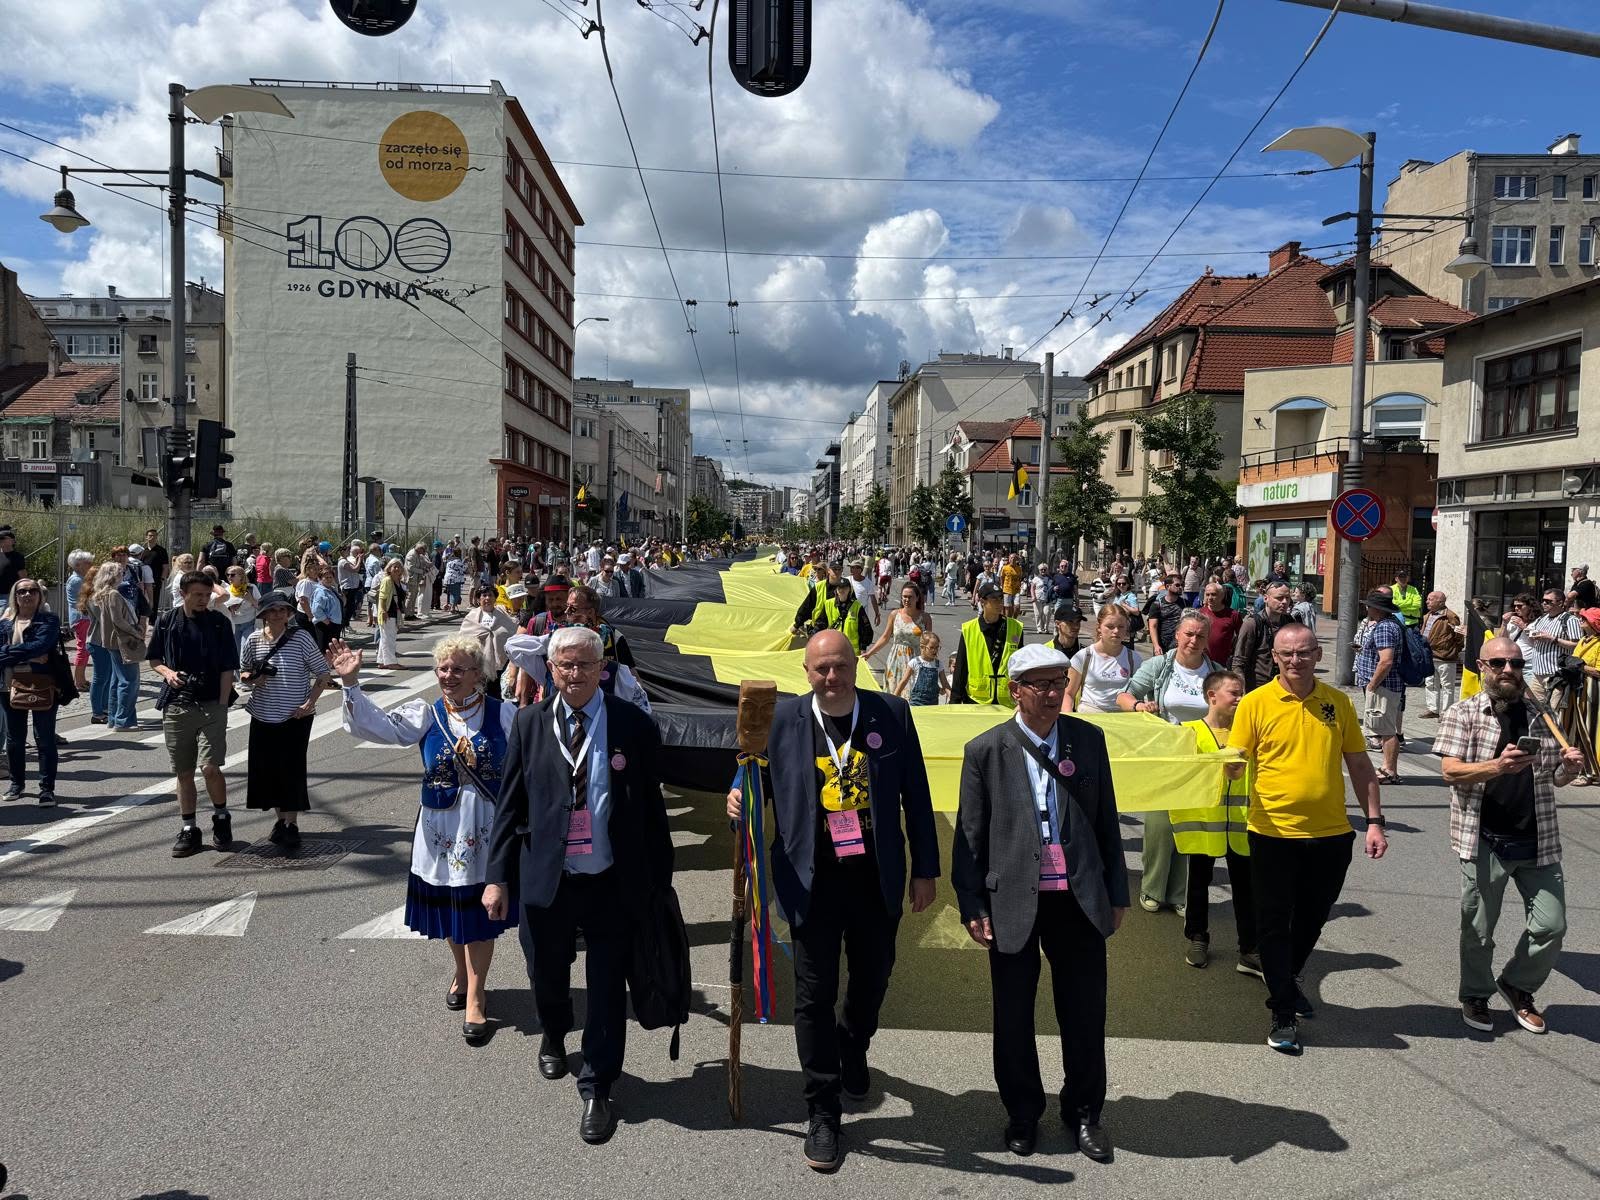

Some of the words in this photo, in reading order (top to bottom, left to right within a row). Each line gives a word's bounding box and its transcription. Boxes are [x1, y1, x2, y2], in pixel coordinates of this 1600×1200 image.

[442, 143, 461, 158] się
[386, 157, 404, 169] od
[408, 160, 452, 170] morza
[287, 215, 451, 273] 100
[287, 283, 311, 292] 1926
[318, 279, 420, 301] GDYNIA
[1263, 483, 1298, 500] natura
